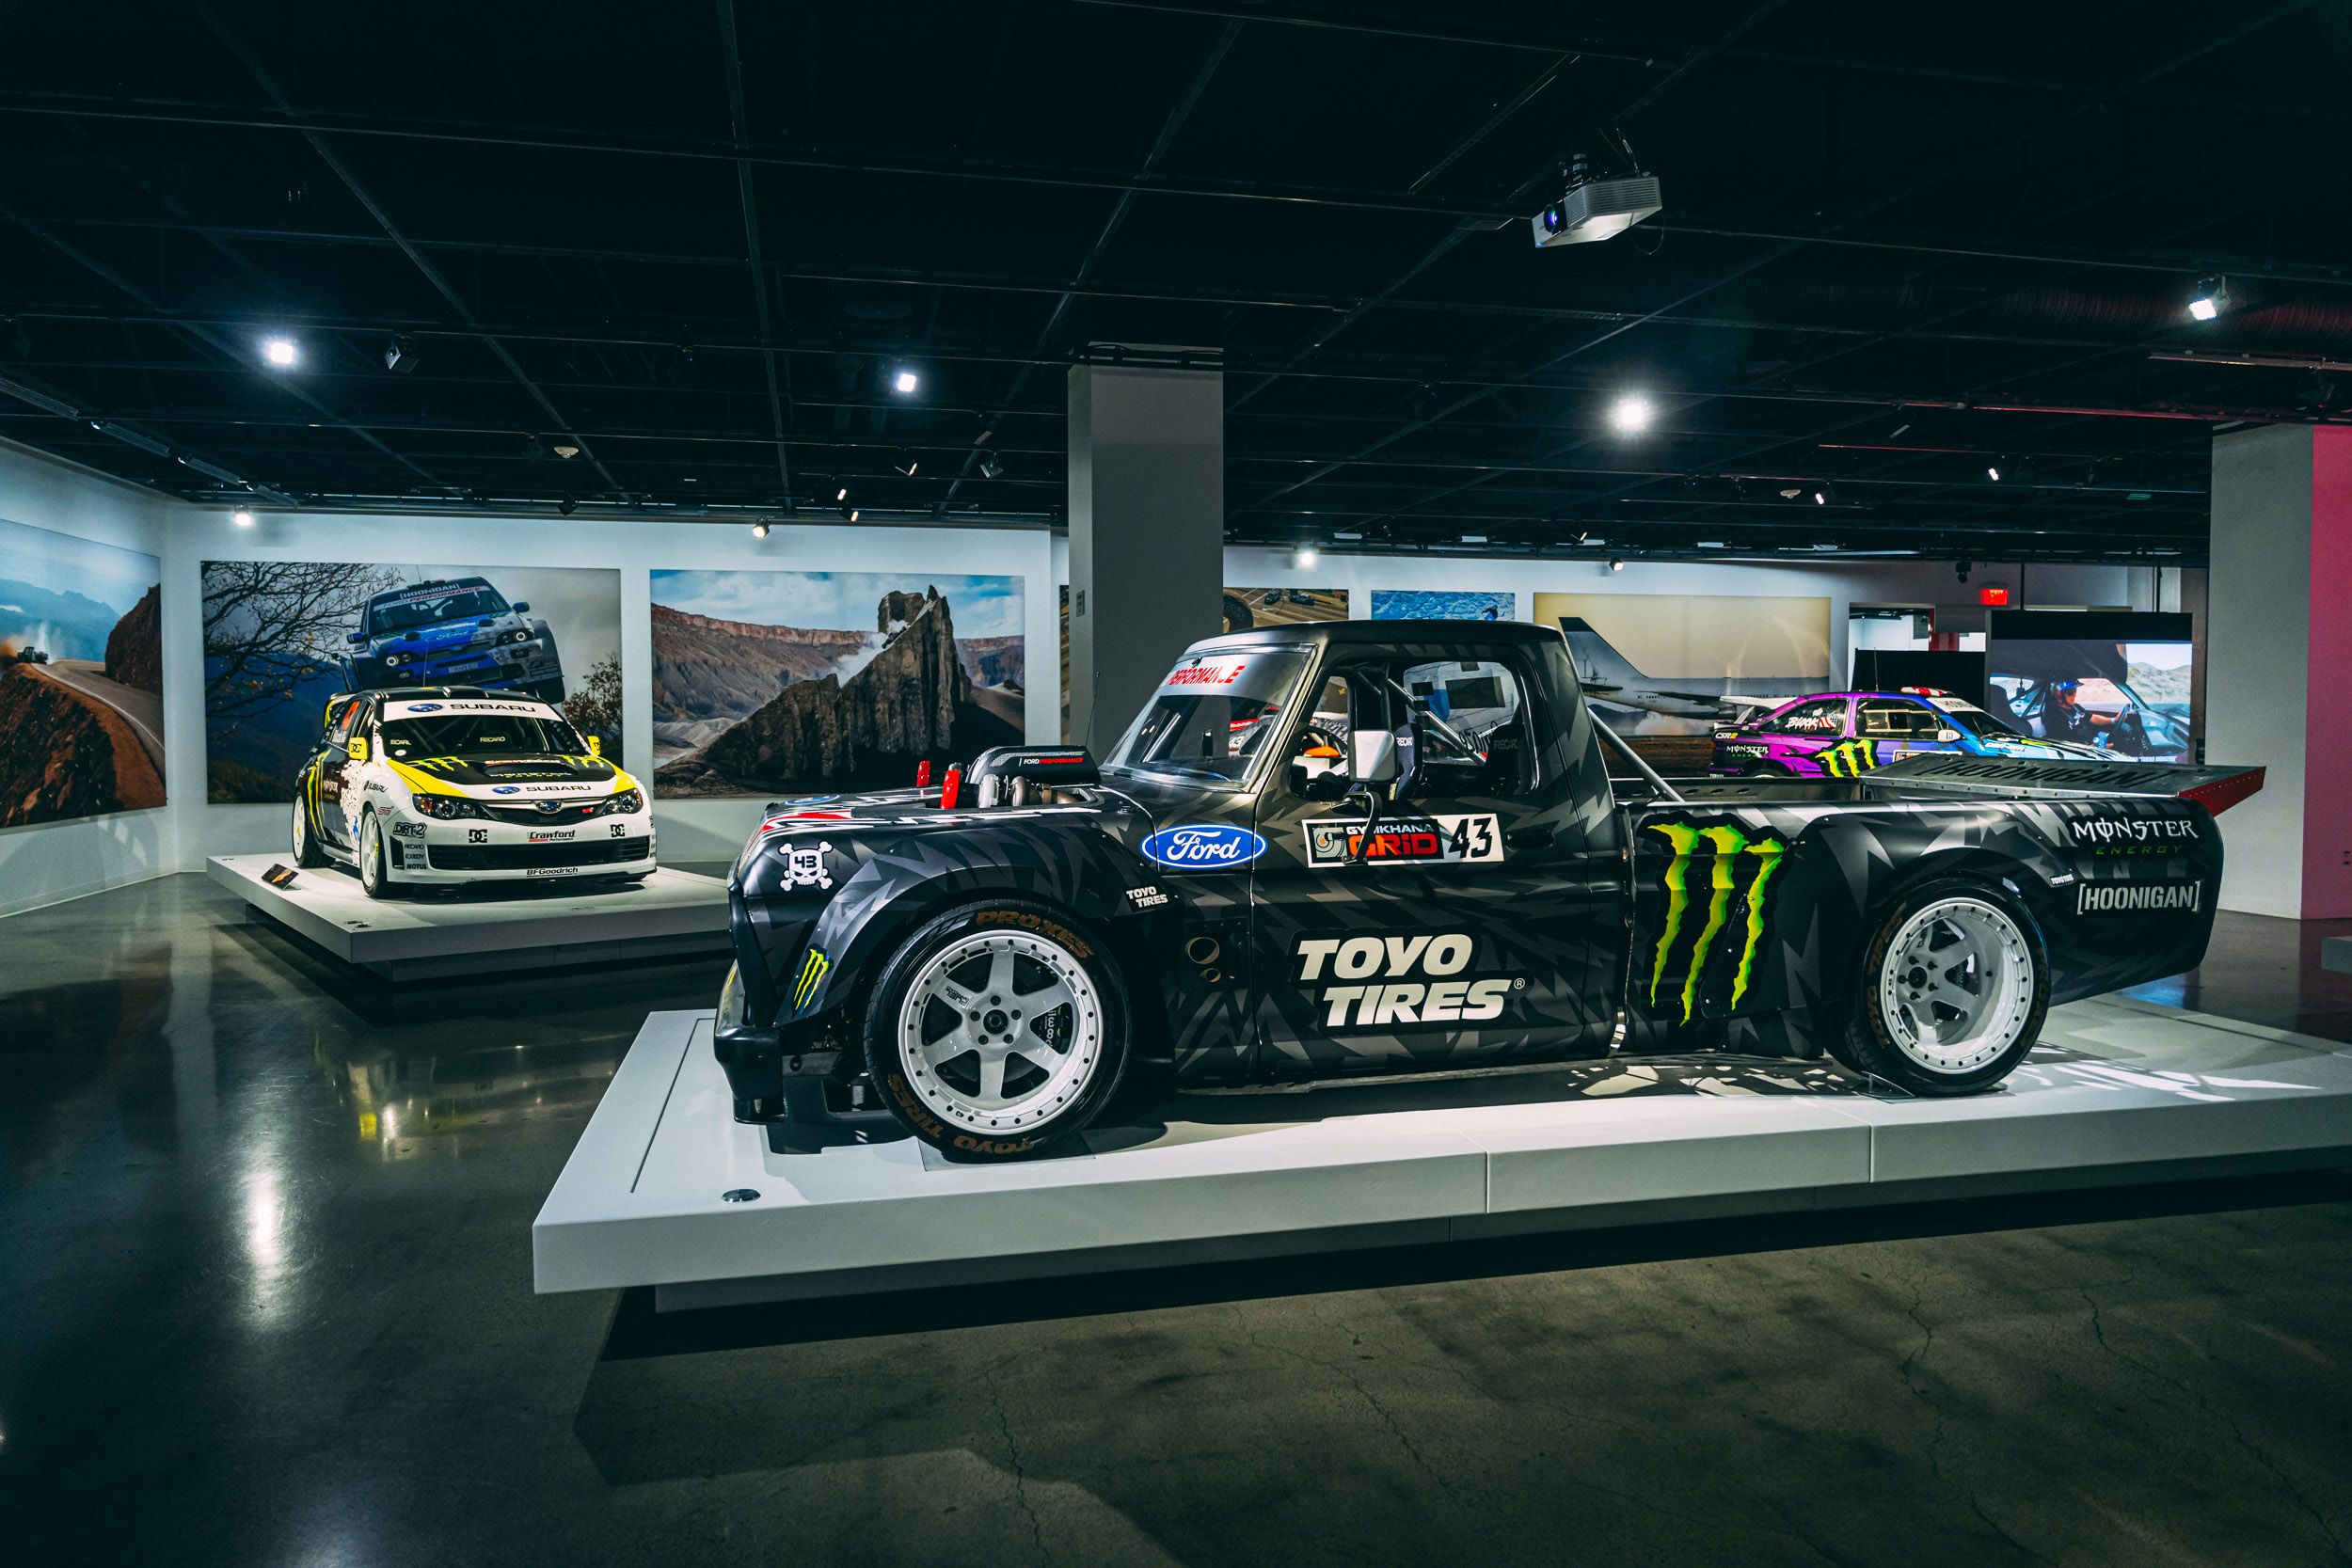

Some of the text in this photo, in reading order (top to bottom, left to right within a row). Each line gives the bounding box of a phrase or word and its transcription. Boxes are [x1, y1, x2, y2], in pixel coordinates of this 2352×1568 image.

[1168, 665, 1247, 686] PERFORMANE
[450, 704, 536, 713] SUBARU
[1726, 744, 1770, 753] MONSTER
[469, 829, 487, 844] DC
[529, 830, 576, 840] Crawford
[610, 823, 626, 838] DC
[2072, 816, 2200, 844] MONSTER
[1167, 830, 1242, 861] Ford
[1448, 816, 1494, 860] 43
[2095, 845, 2183, 855] ENERGY
[794, 855, 818, 869] 43
[526, 866, 579, 877] BFGoodrich
[1126, 886, 1157, 899] TOYO
[2076, 880, 2201, 915] [HOONIGAN]
[1135, 894, 1168, 908] TIRES
[976, 911, 1095, 958] PROXES
[1297, 933, 1473, 981] TOYO
[887, 1073, 945, 1139] TIRES
[953, 1135, 1035, 1155] TOYO
